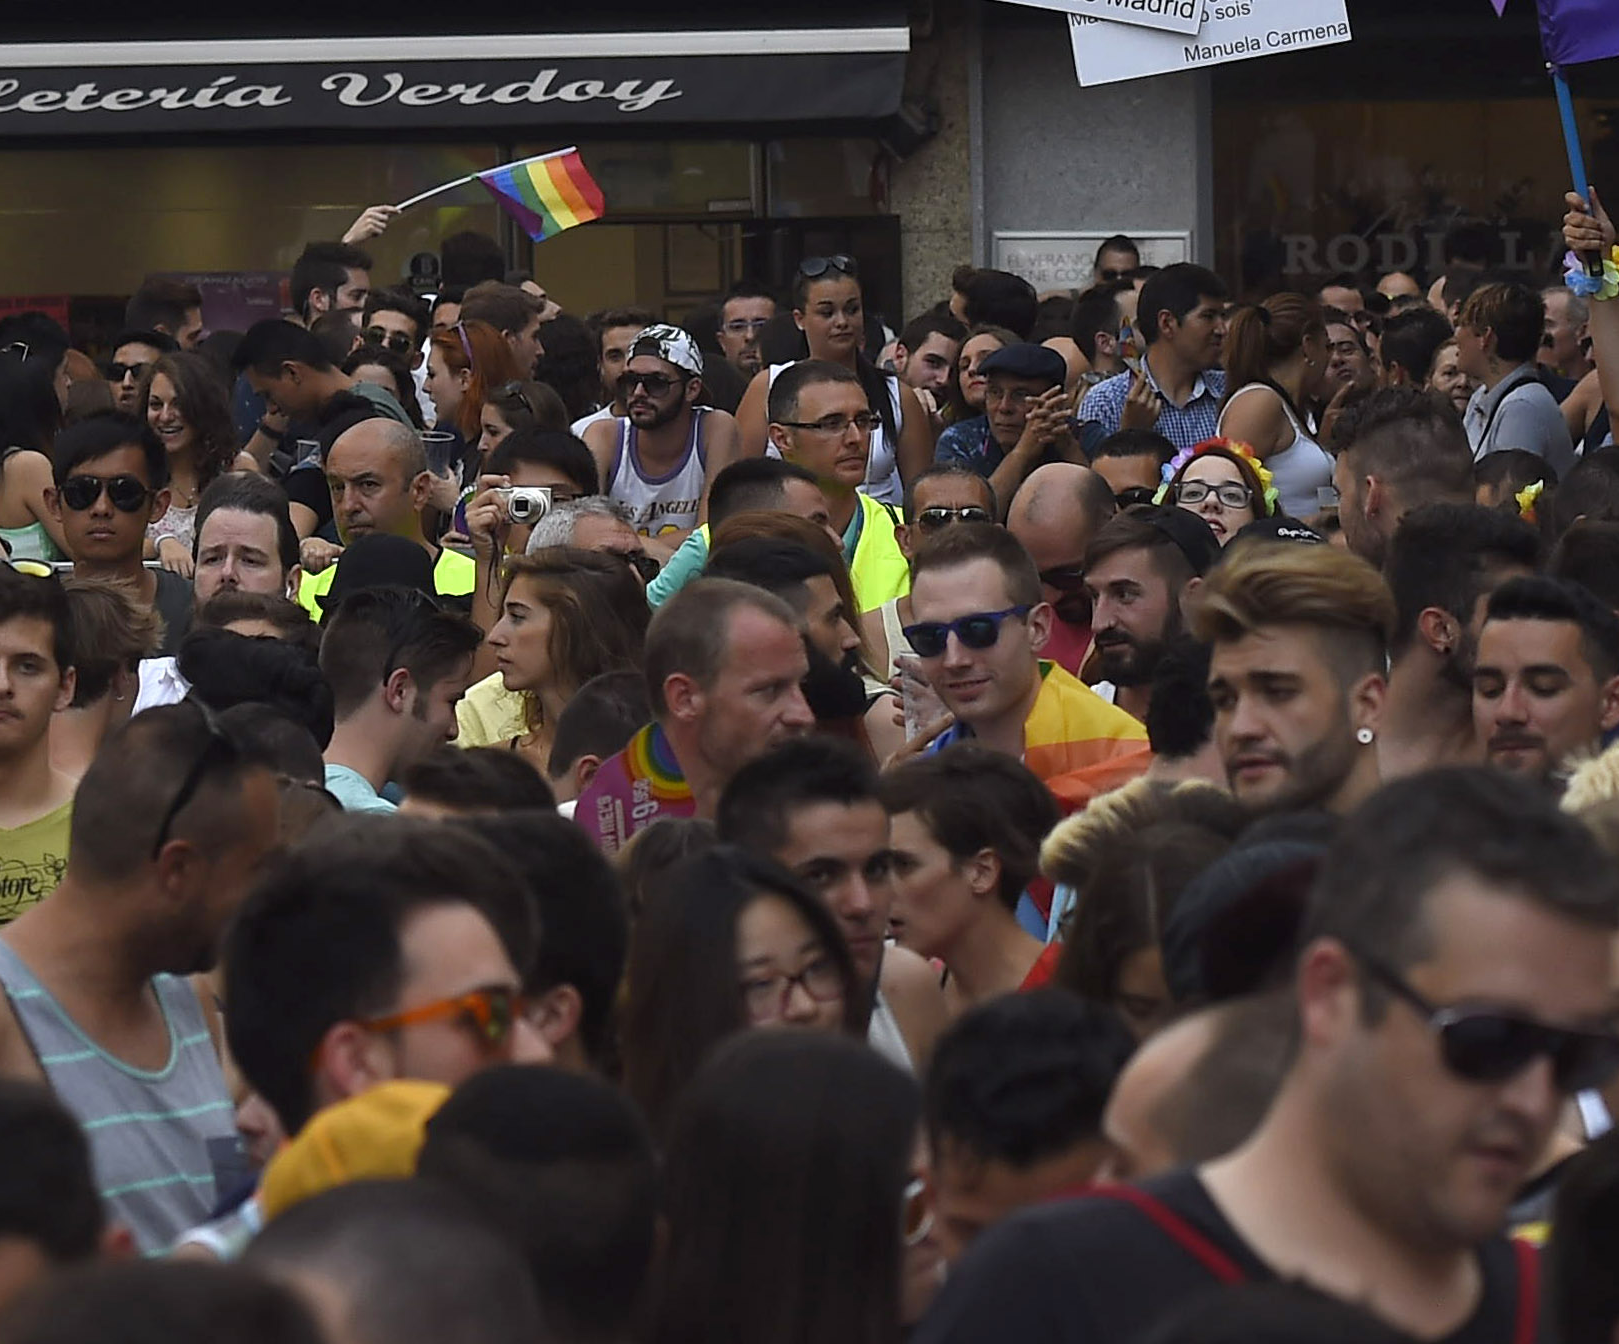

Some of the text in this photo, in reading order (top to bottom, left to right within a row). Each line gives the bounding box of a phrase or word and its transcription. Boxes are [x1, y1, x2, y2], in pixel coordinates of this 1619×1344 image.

[1183, 21, 1350, 64] Manuela Carmena
[320, 68, 683, 113] Verdoy
